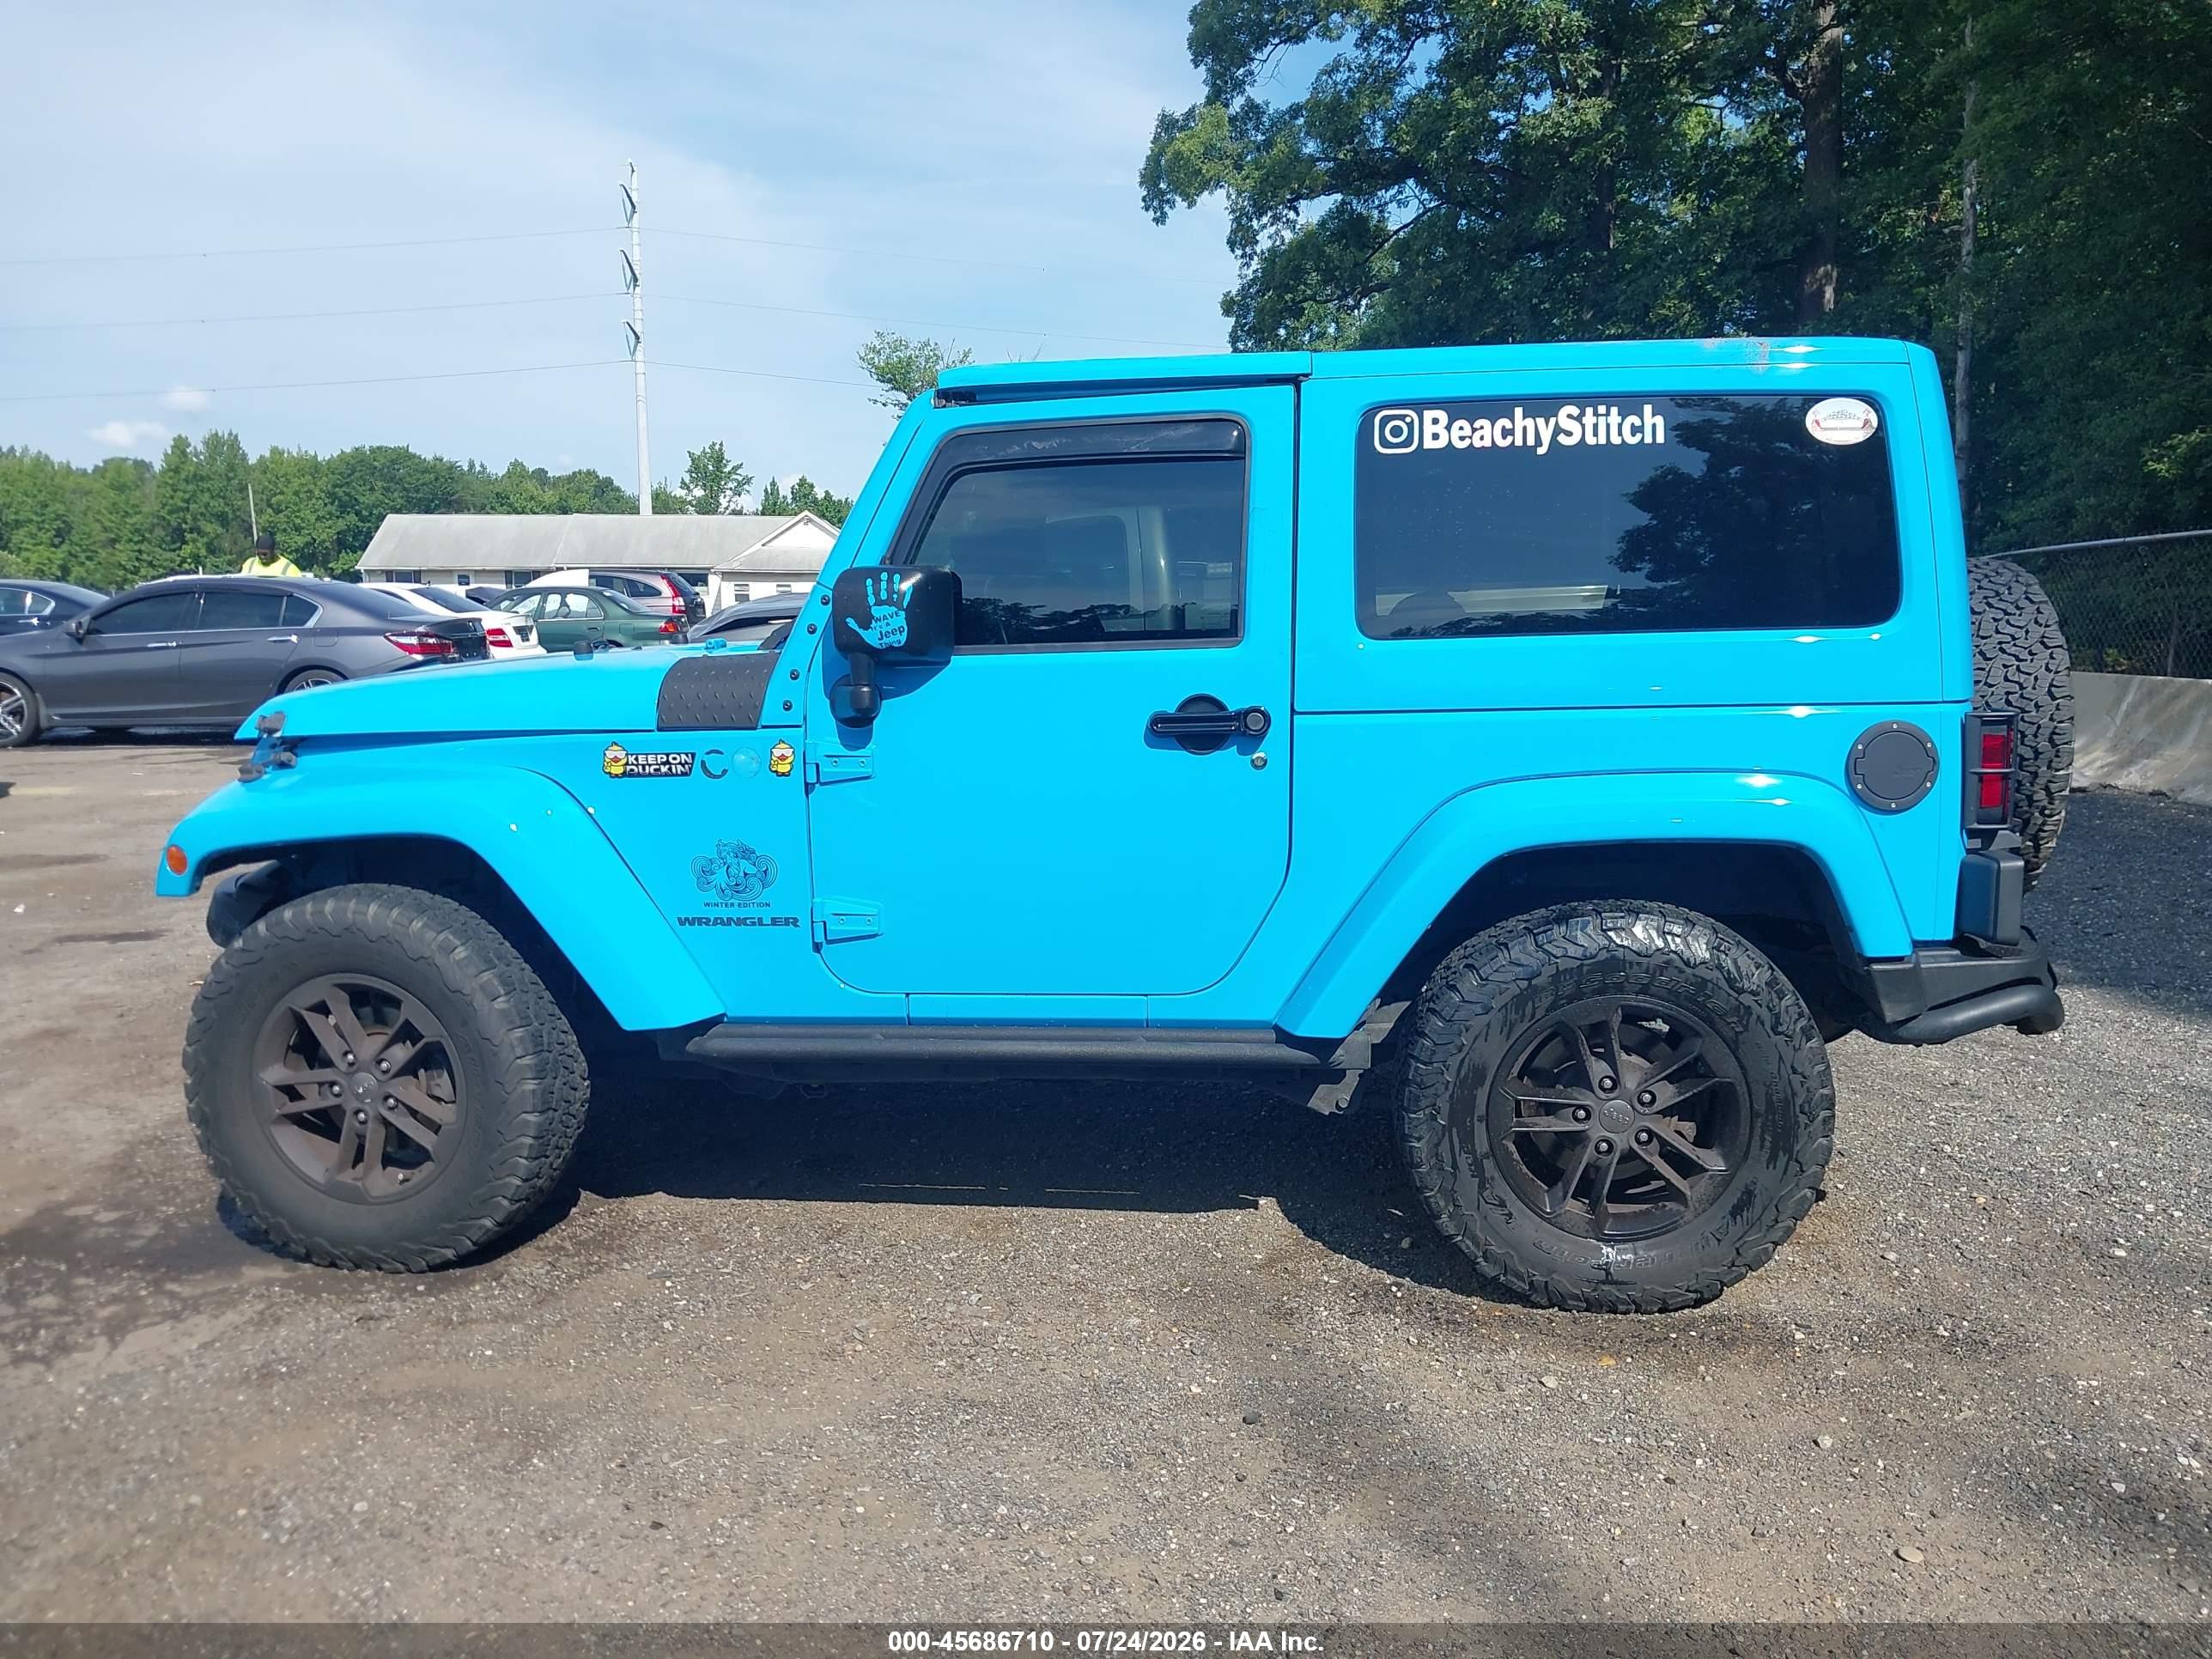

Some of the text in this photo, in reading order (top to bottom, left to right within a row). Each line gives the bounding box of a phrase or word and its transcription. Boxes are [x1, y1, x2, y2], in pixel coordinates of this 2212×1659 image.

[1423, 404, 1665, 455] BeachyStitch
[872, 611, 901, 623] WAVE
[878, 625, 905, 641] Jeep
[627, 753, 692, 764] KEEP ON
[678, 916, 800, 927] WRANGLER
